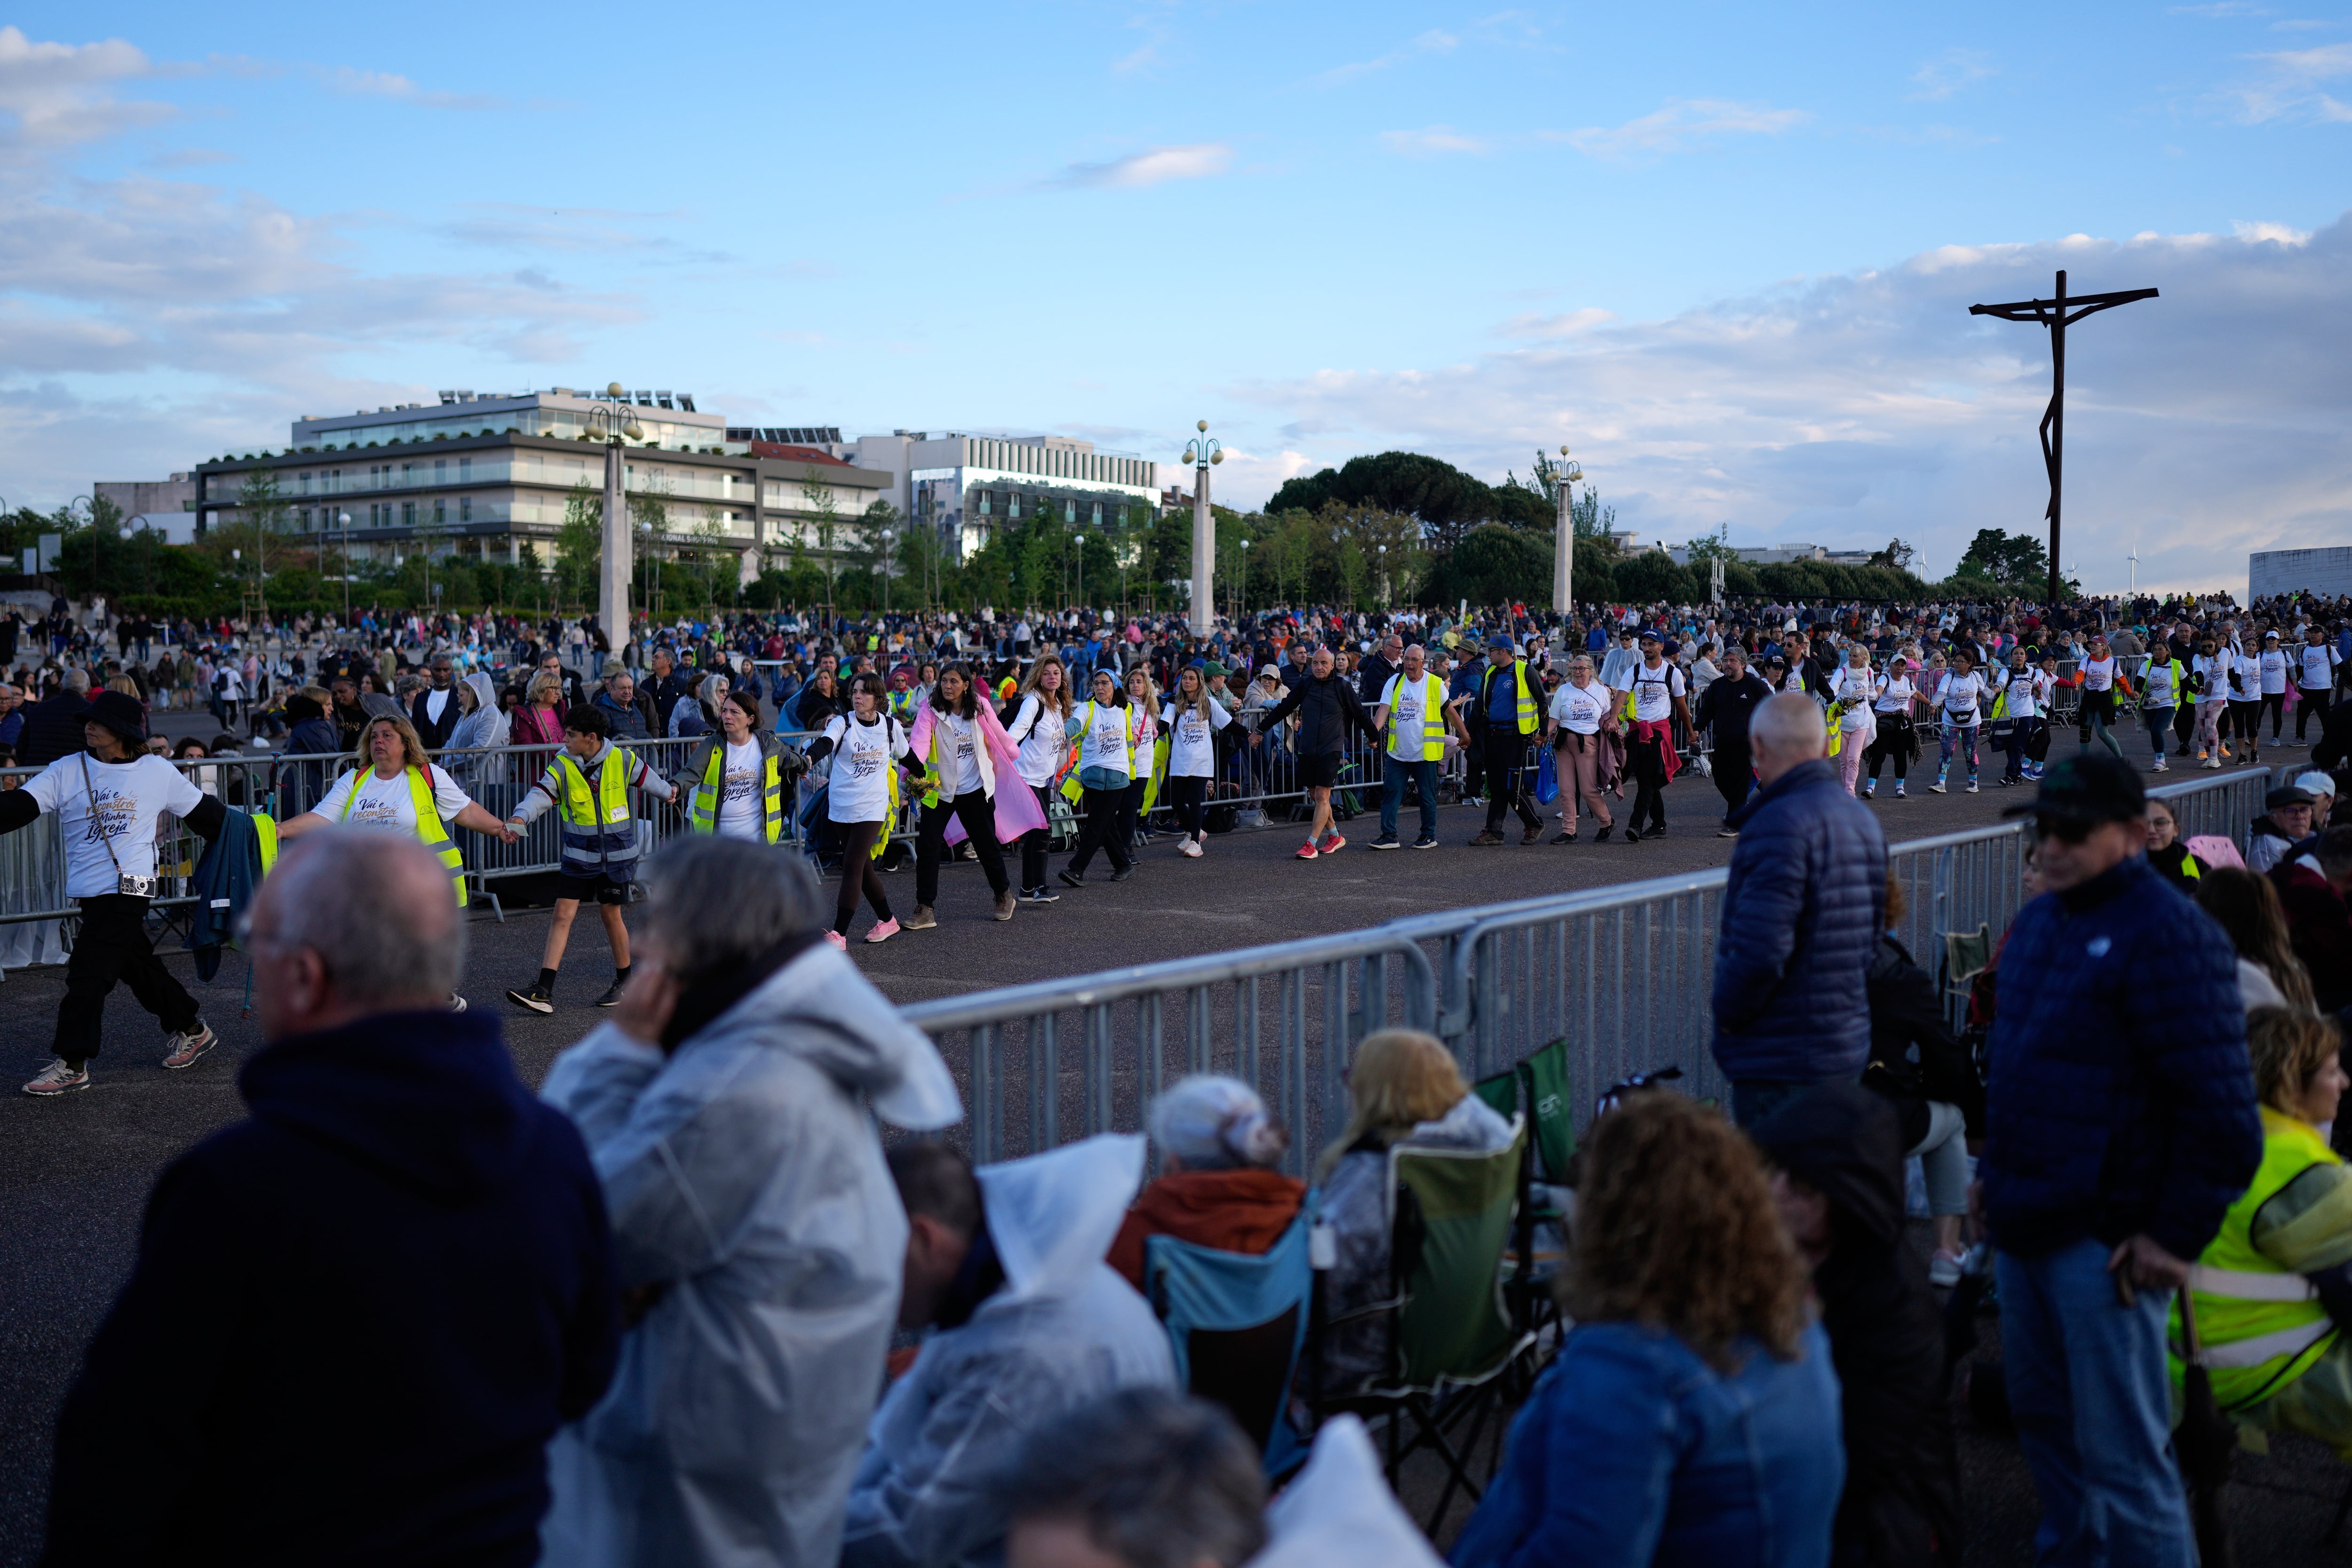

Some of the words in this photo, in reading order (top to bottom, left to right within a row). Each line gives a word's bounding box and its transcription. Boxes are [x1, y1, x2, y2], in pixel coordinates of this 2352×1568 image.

[1638, 695, 1661, 706] Igreja
[1396, 711, 1417, 723] Igreja
[1099, 723, 1111, 732] Vai
[1141, 734, 1152, 745] reja
[1183, 734, 1204, 745] Igreja
[850, 749, 883, 760] reconstrói
[957, 745, 975, 759] reja
[1049, 743, 1060, 757] Igr
[1099, 742, 1122, 756] Igreja
[725, 769, 757, 780] constrói
[729, 780, 749, 788] Minha
[91, 788, 111, 804] Vai
[723, 786, 753, 802] greja
[86, 797, 138, 817] rconstrói
[359, 798, 377, 811] Vai
[100, 812, 127, 823] Minha
[352, 806, 399, 821] reconstrói
[85, 821, 130, 844] Igreja
